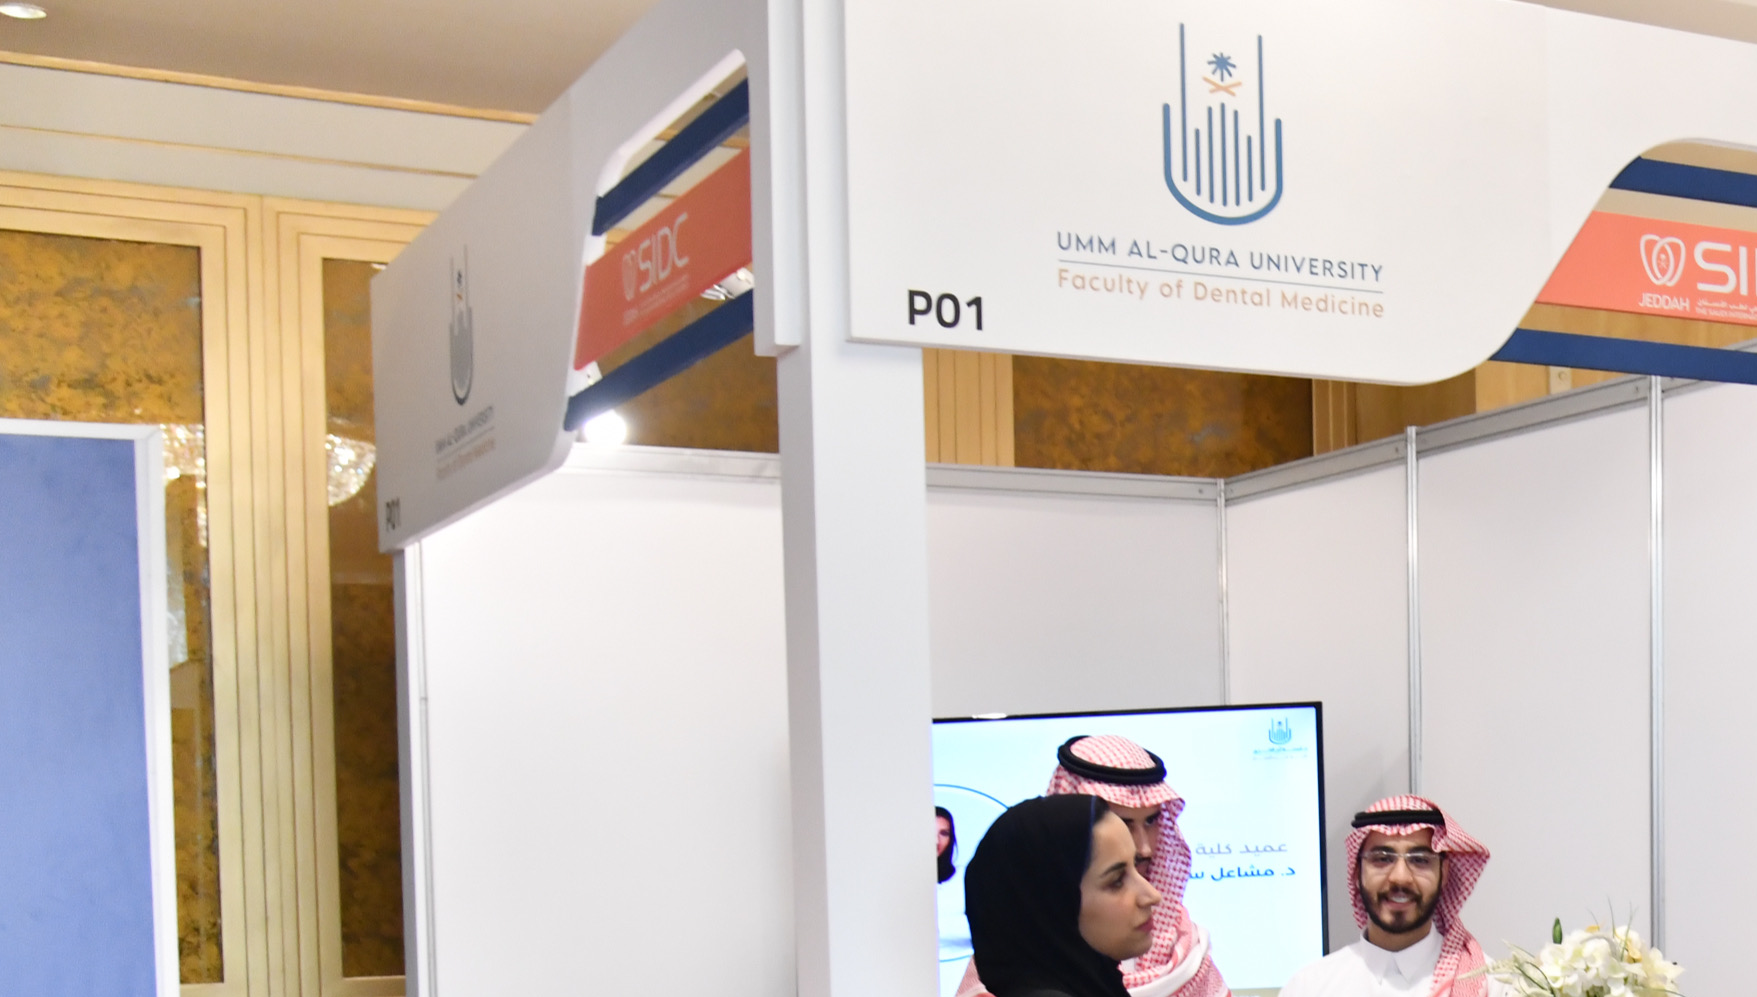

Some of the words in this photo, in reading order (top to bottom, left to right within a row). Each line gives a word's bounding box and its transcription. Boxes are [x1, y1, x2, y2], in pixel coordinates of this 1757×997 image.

[638, 212, 690, 293] SIDC
[1057, 231, 1116, 256] UMM
[1128, 238, 1239, 268] AL-QURA
[1250, 251, 1383, 282] UNIVERSITY
[1058, 268, 1148, 300] Faculty
[1160, 279, 1184, 298] of
[1194, 281, 1270, 307] Dental
[1281, 290, 1384, 318] Medicine
[1638, 292, 1690, 312] JEDDAH
[907, 288, 984, 332] P01
[1196, 842, 1232, 858] كلية
[1240, 843, 1288, 857] عميد
[1211, 864, 1275, 882] مشاعل
